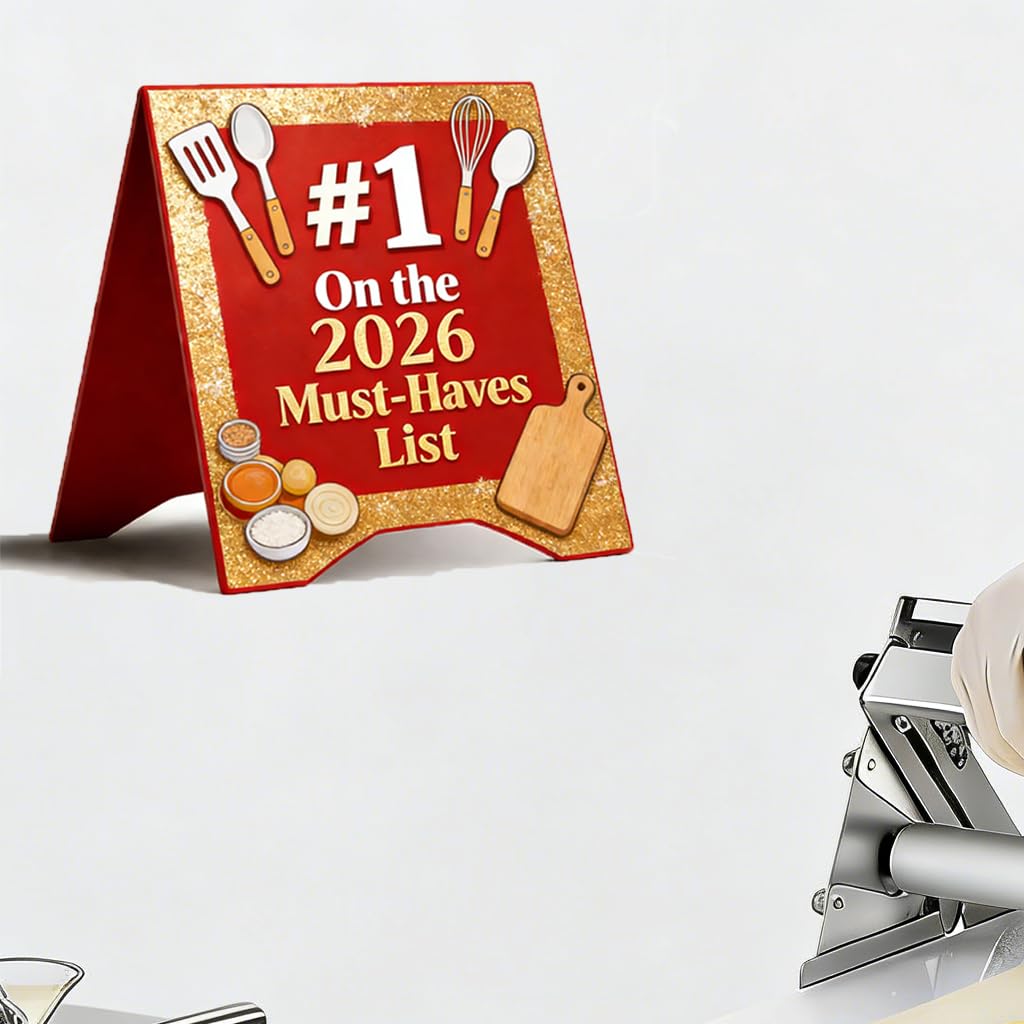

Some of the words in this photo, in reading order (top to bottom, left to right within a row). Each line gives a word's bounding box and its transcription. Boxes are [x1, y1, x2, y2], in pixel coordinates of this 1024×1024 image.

[306, 144, 442, 249] #1
[314, 270, 383, 311] On
[390, 264, 461, 304] the
[310, 308, 475, 373] 2026
[275, 372, 533, 427] Must-Haves
[374, 423, 460, 469] List
